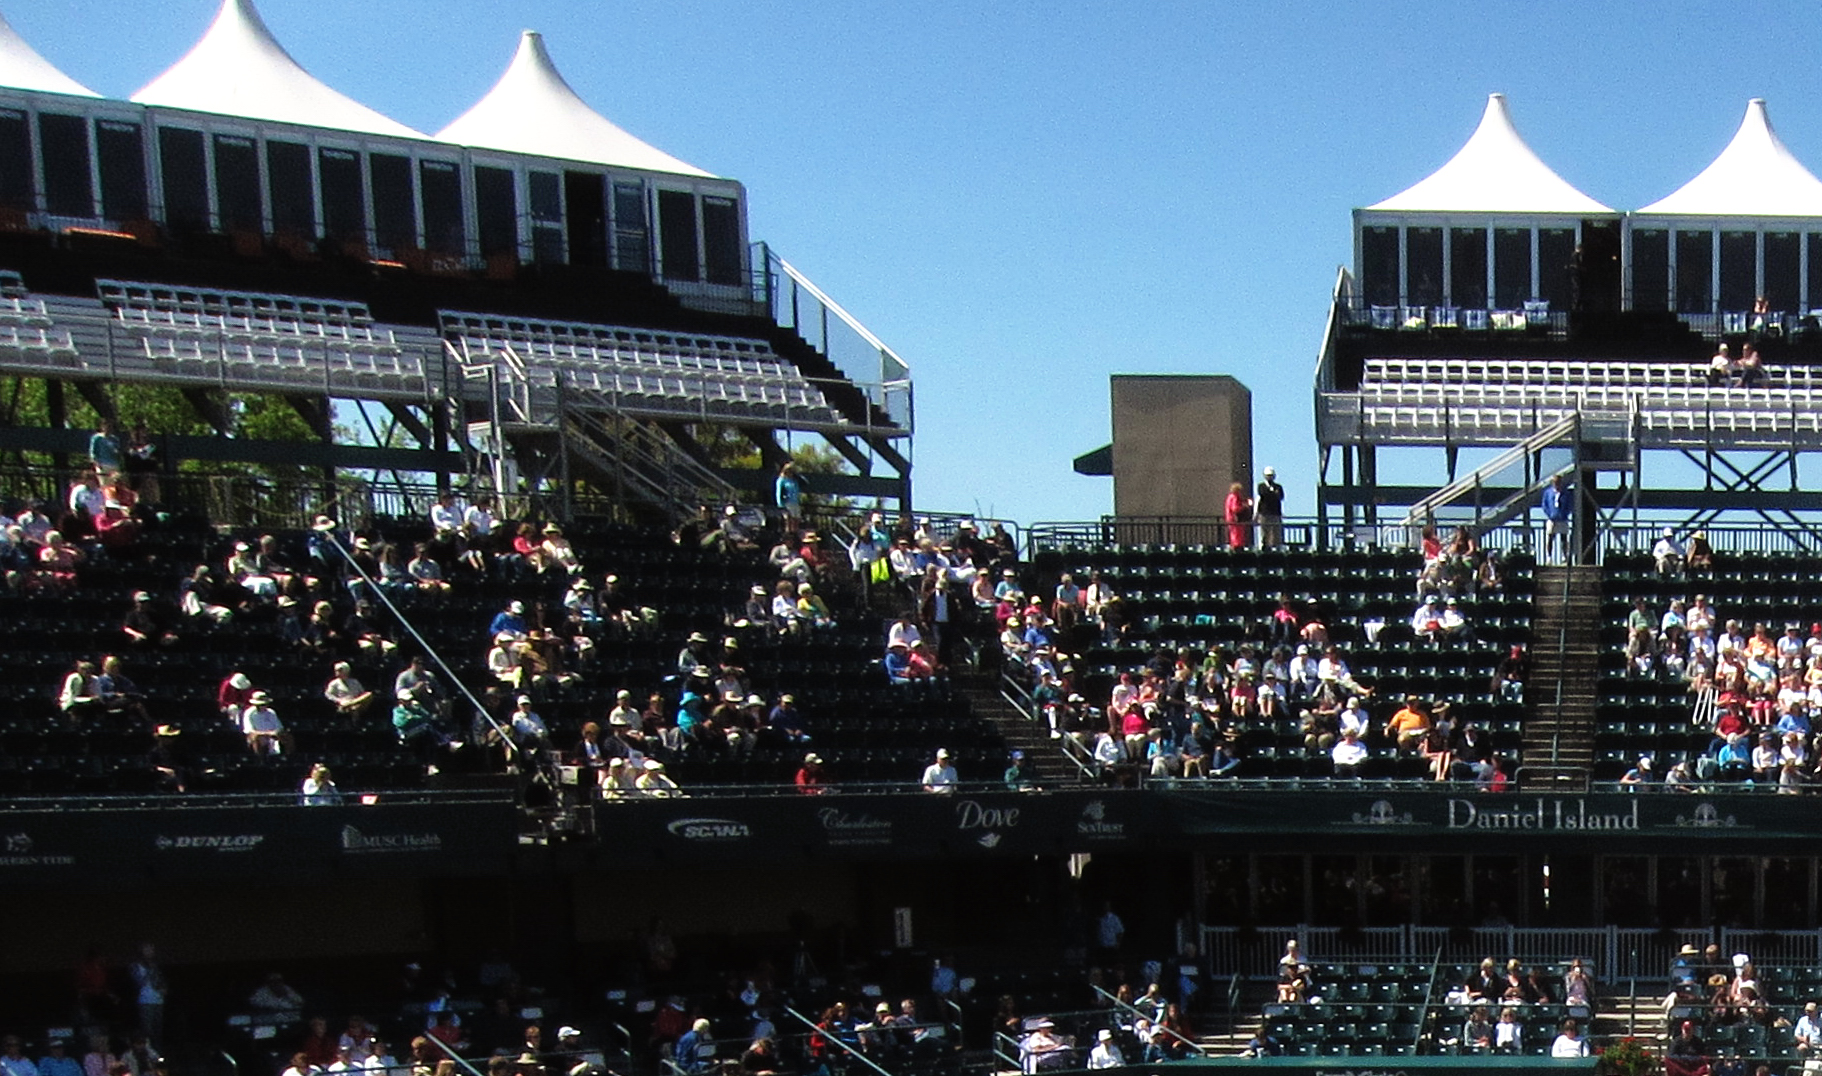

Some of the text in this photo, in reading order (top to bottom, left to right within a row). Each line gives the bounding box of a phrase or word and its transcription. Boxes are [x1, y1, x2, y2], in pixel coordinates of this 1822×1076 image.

[956, 800, 1020, 829] Dove
[1448, 799, 1639, 830] Daniel Island
[174, 835, 264, 848] DUNLOP
